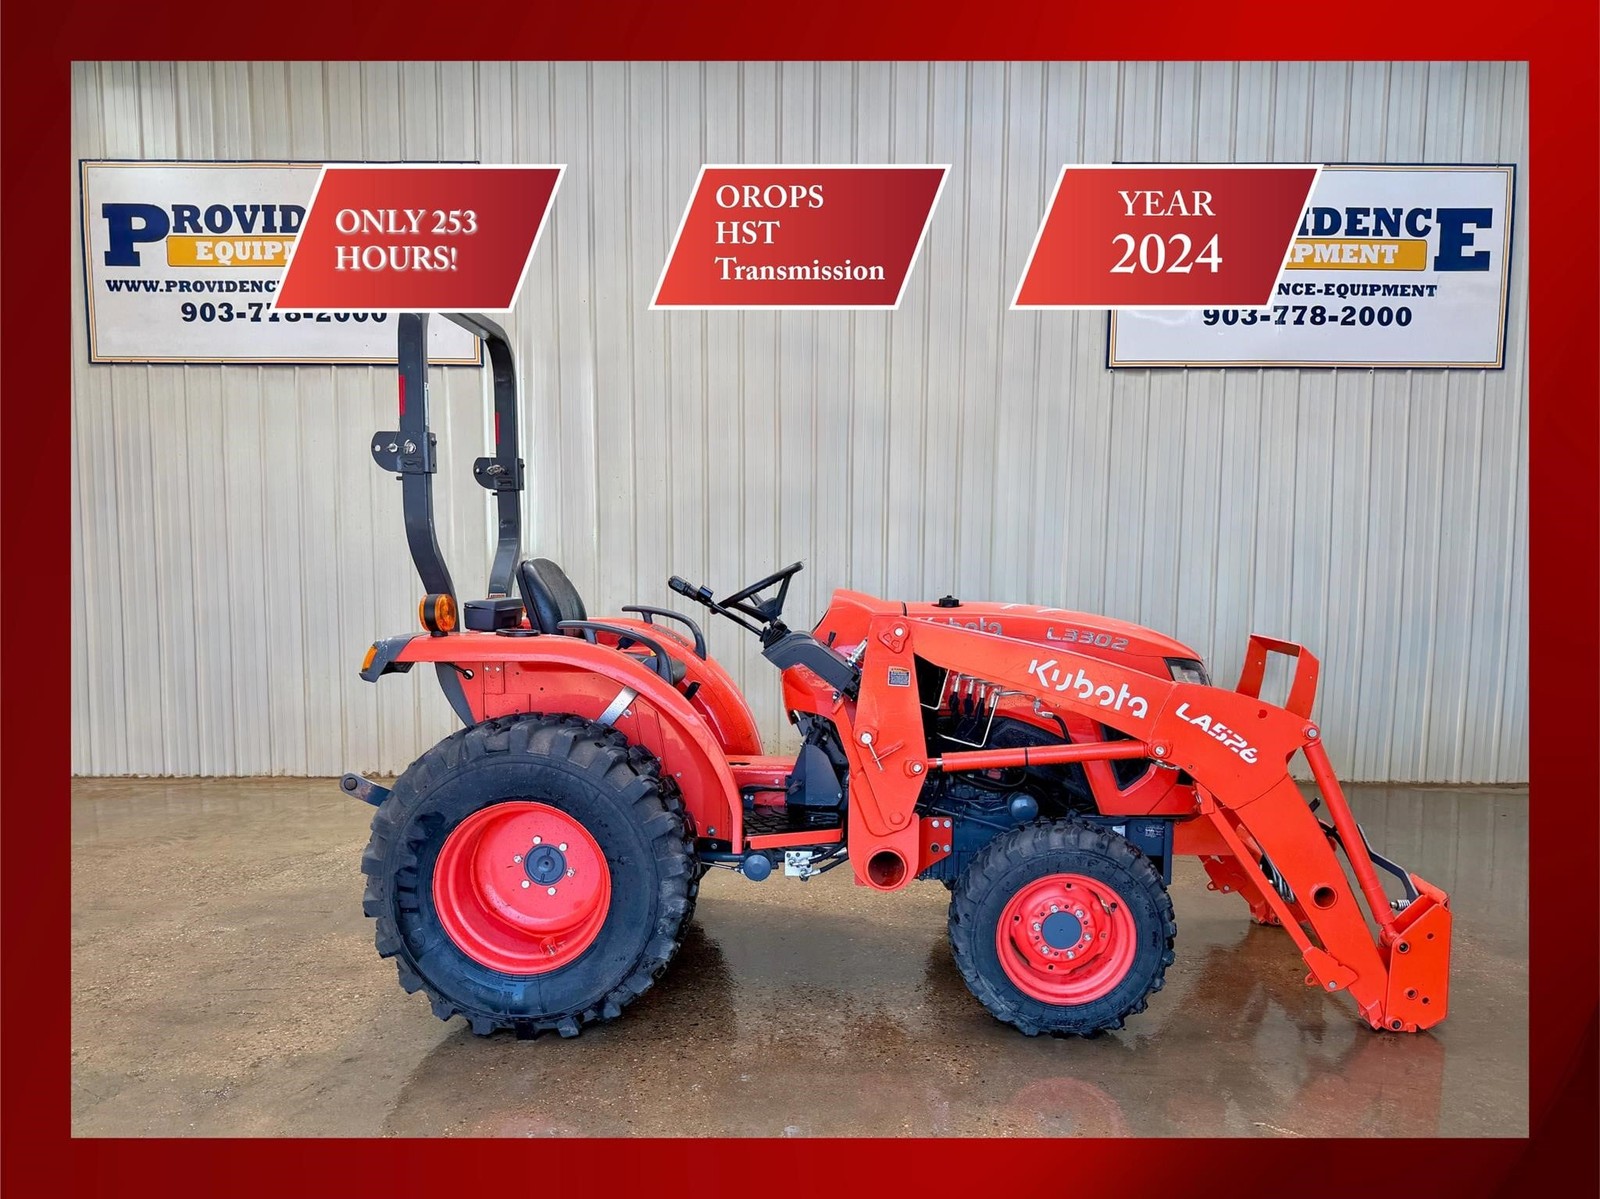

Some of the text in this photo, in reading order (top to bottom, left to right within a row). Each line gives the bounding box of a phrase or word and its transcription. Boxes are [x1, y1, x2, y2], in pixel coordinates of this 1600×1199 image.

[105, 279, 281, 293] WWW.PROVIDENC
[1203, 305, 1413, 327] 903-778-2000
[1046, 626, 1129, 651] L3302
[1027, 659, 1149, 719] Kubota
[1175, 702, 1258, 764] LA526
